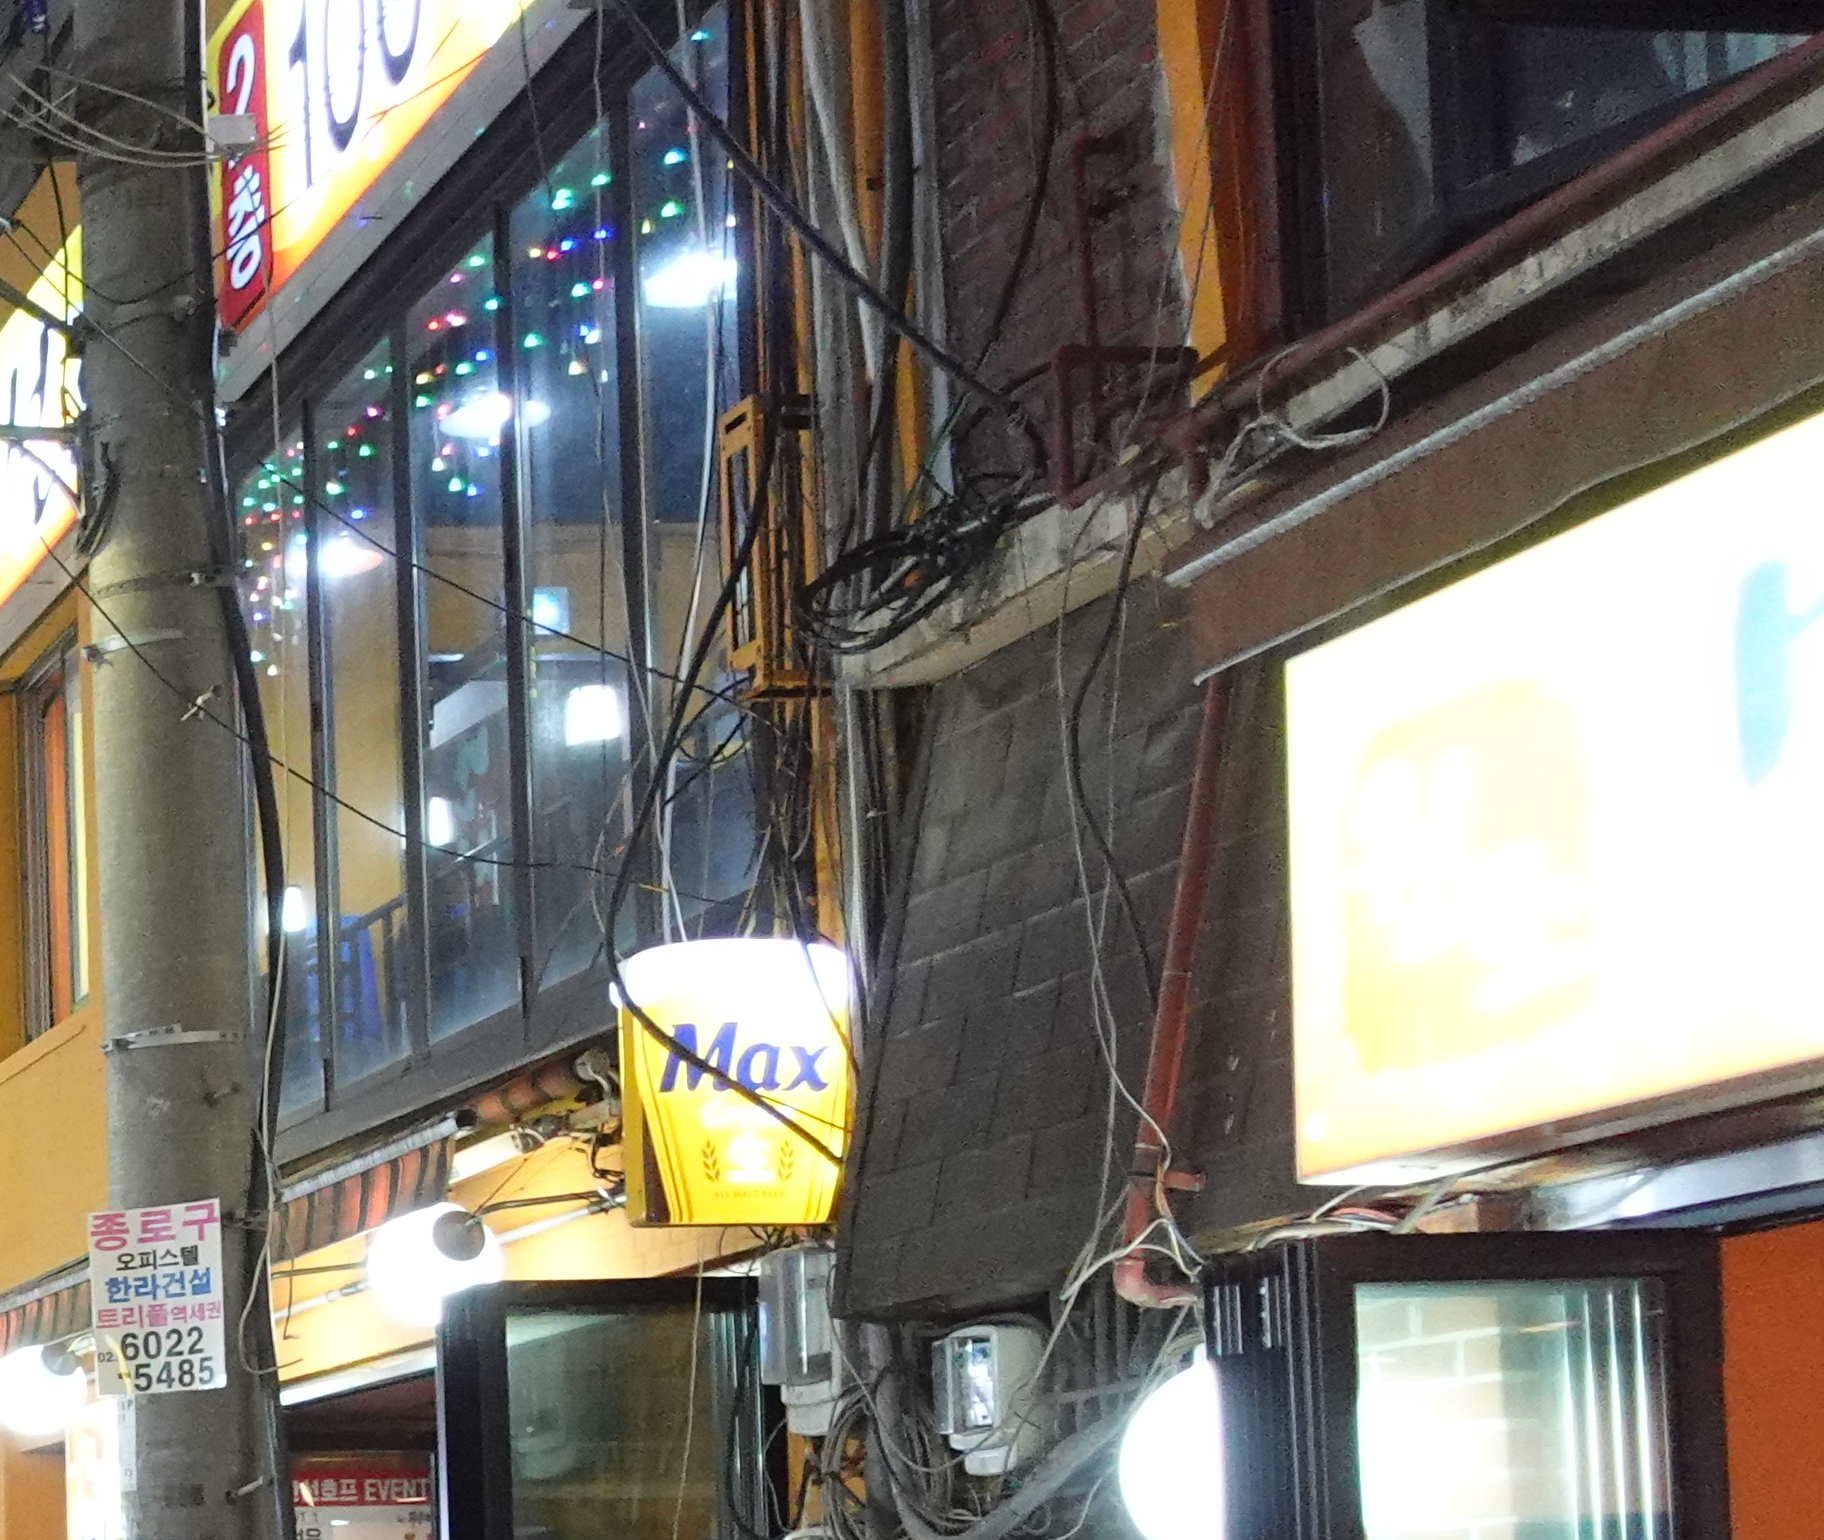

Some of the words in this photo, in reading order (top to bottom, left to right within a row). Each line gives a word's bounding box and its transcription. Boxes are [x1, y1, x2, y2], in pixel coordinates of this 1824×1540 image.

[658, 1021, 830, 1093] Max
[90, 1202, 219, 1252] 종로구
[115, 1244, 200, 1273] 오피스텔
[104, 1266, 213, 1304] 한라건설
[120, 1325, 205, 1361] 6022
